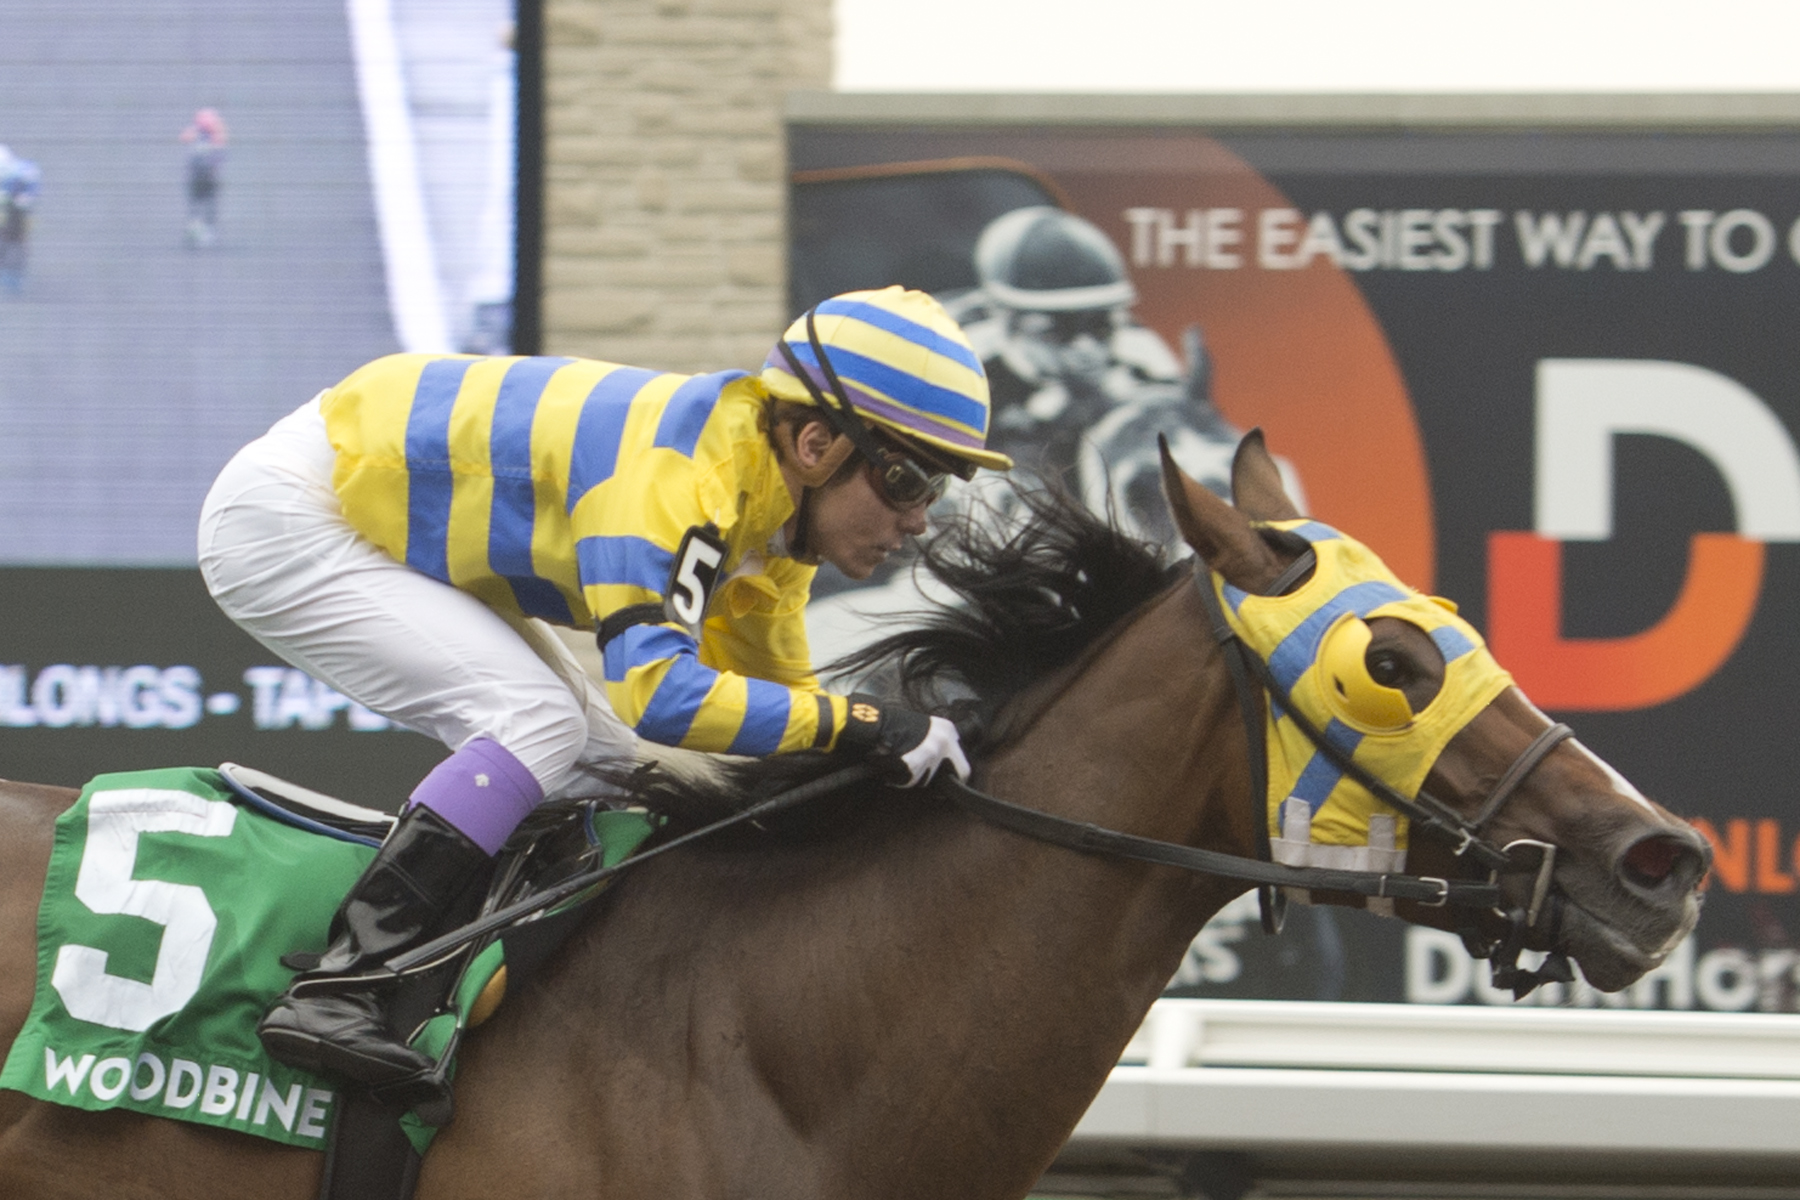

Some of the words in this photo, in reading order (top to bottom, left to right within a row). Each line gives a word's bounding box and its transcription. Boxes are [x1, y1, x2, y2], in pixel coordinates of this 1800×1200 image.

[1121, 207, 1245, 270] THE
[1256, 207, 1503, 272] EASIEST
[1513, 209, 1667, 272] WAY
[1677, 208, 1777, 274] TO
[672, 536, 722, 625] 5
[51, 787, 238, 1032] 5
[45, 1046, 333, 1139] WOODBINE
